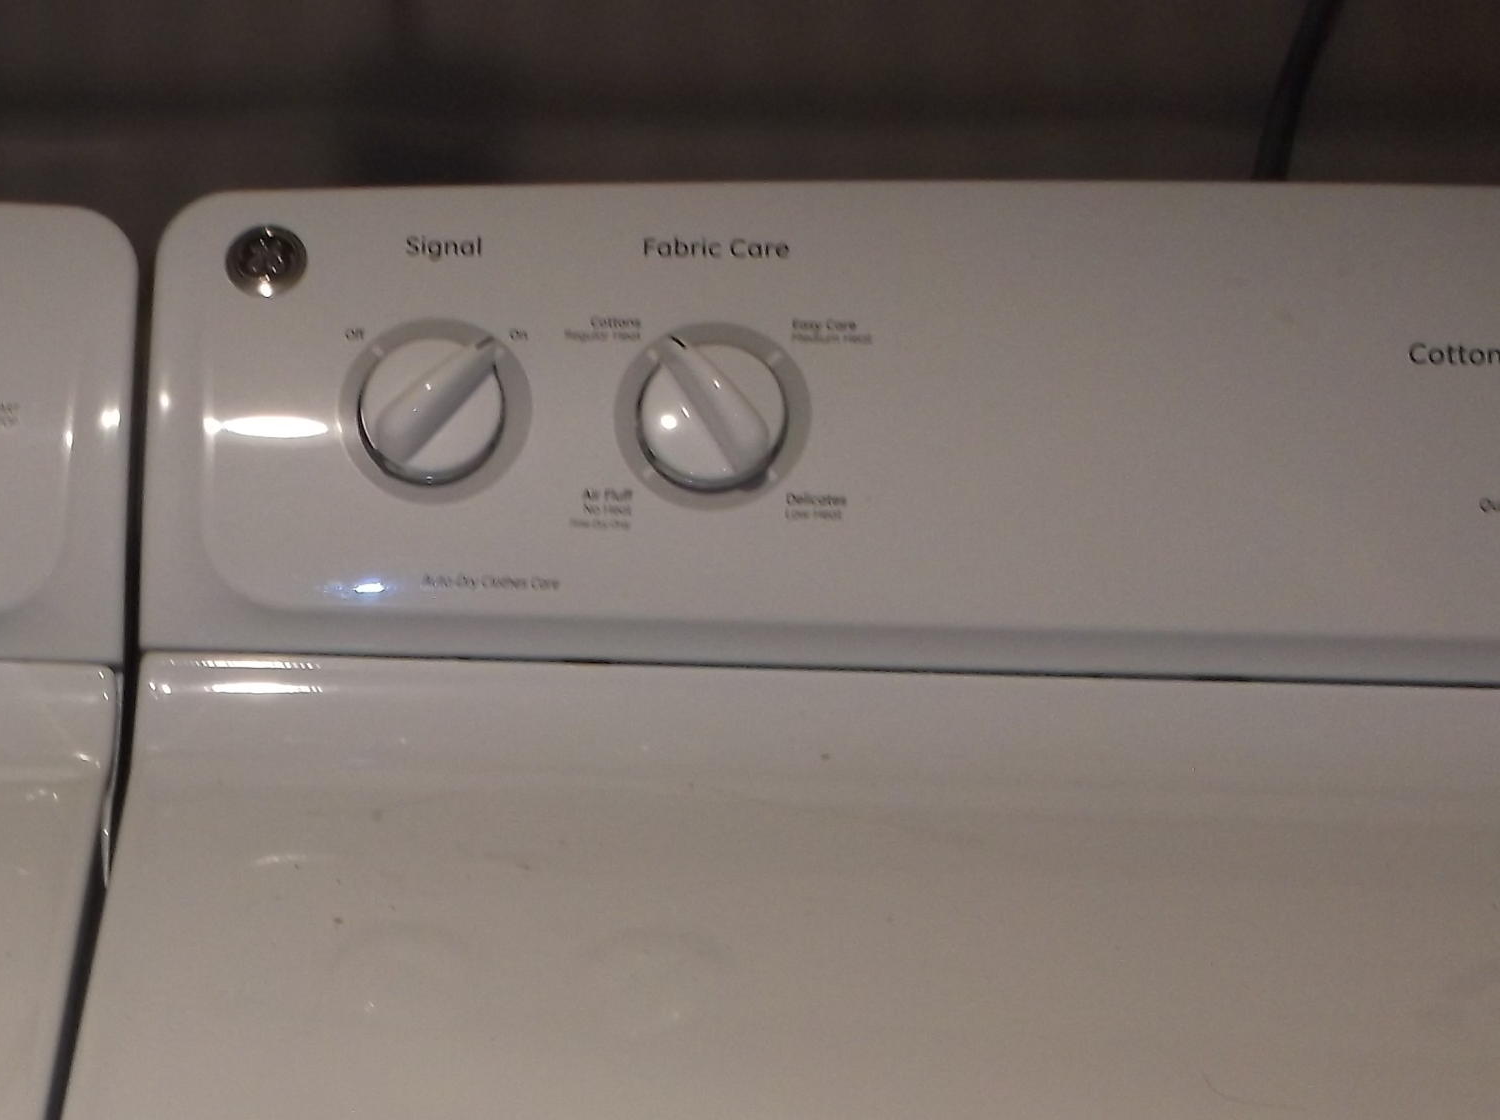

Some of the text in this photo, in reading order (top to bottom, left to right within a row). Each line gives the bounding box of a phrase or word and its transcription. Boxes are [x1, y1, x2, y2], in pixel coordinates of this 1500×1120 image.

[404, 234, 484, 262] Signal
[642, 236, 791, 259] Fabric Care
[589, 314, 642, 329] Cottons
[791, 316, 858, 332] Easy Care
[343, 327, 366, 341] Off
[508, 328, 529, 341] On
[785, 491, 848, 506] Delicates
